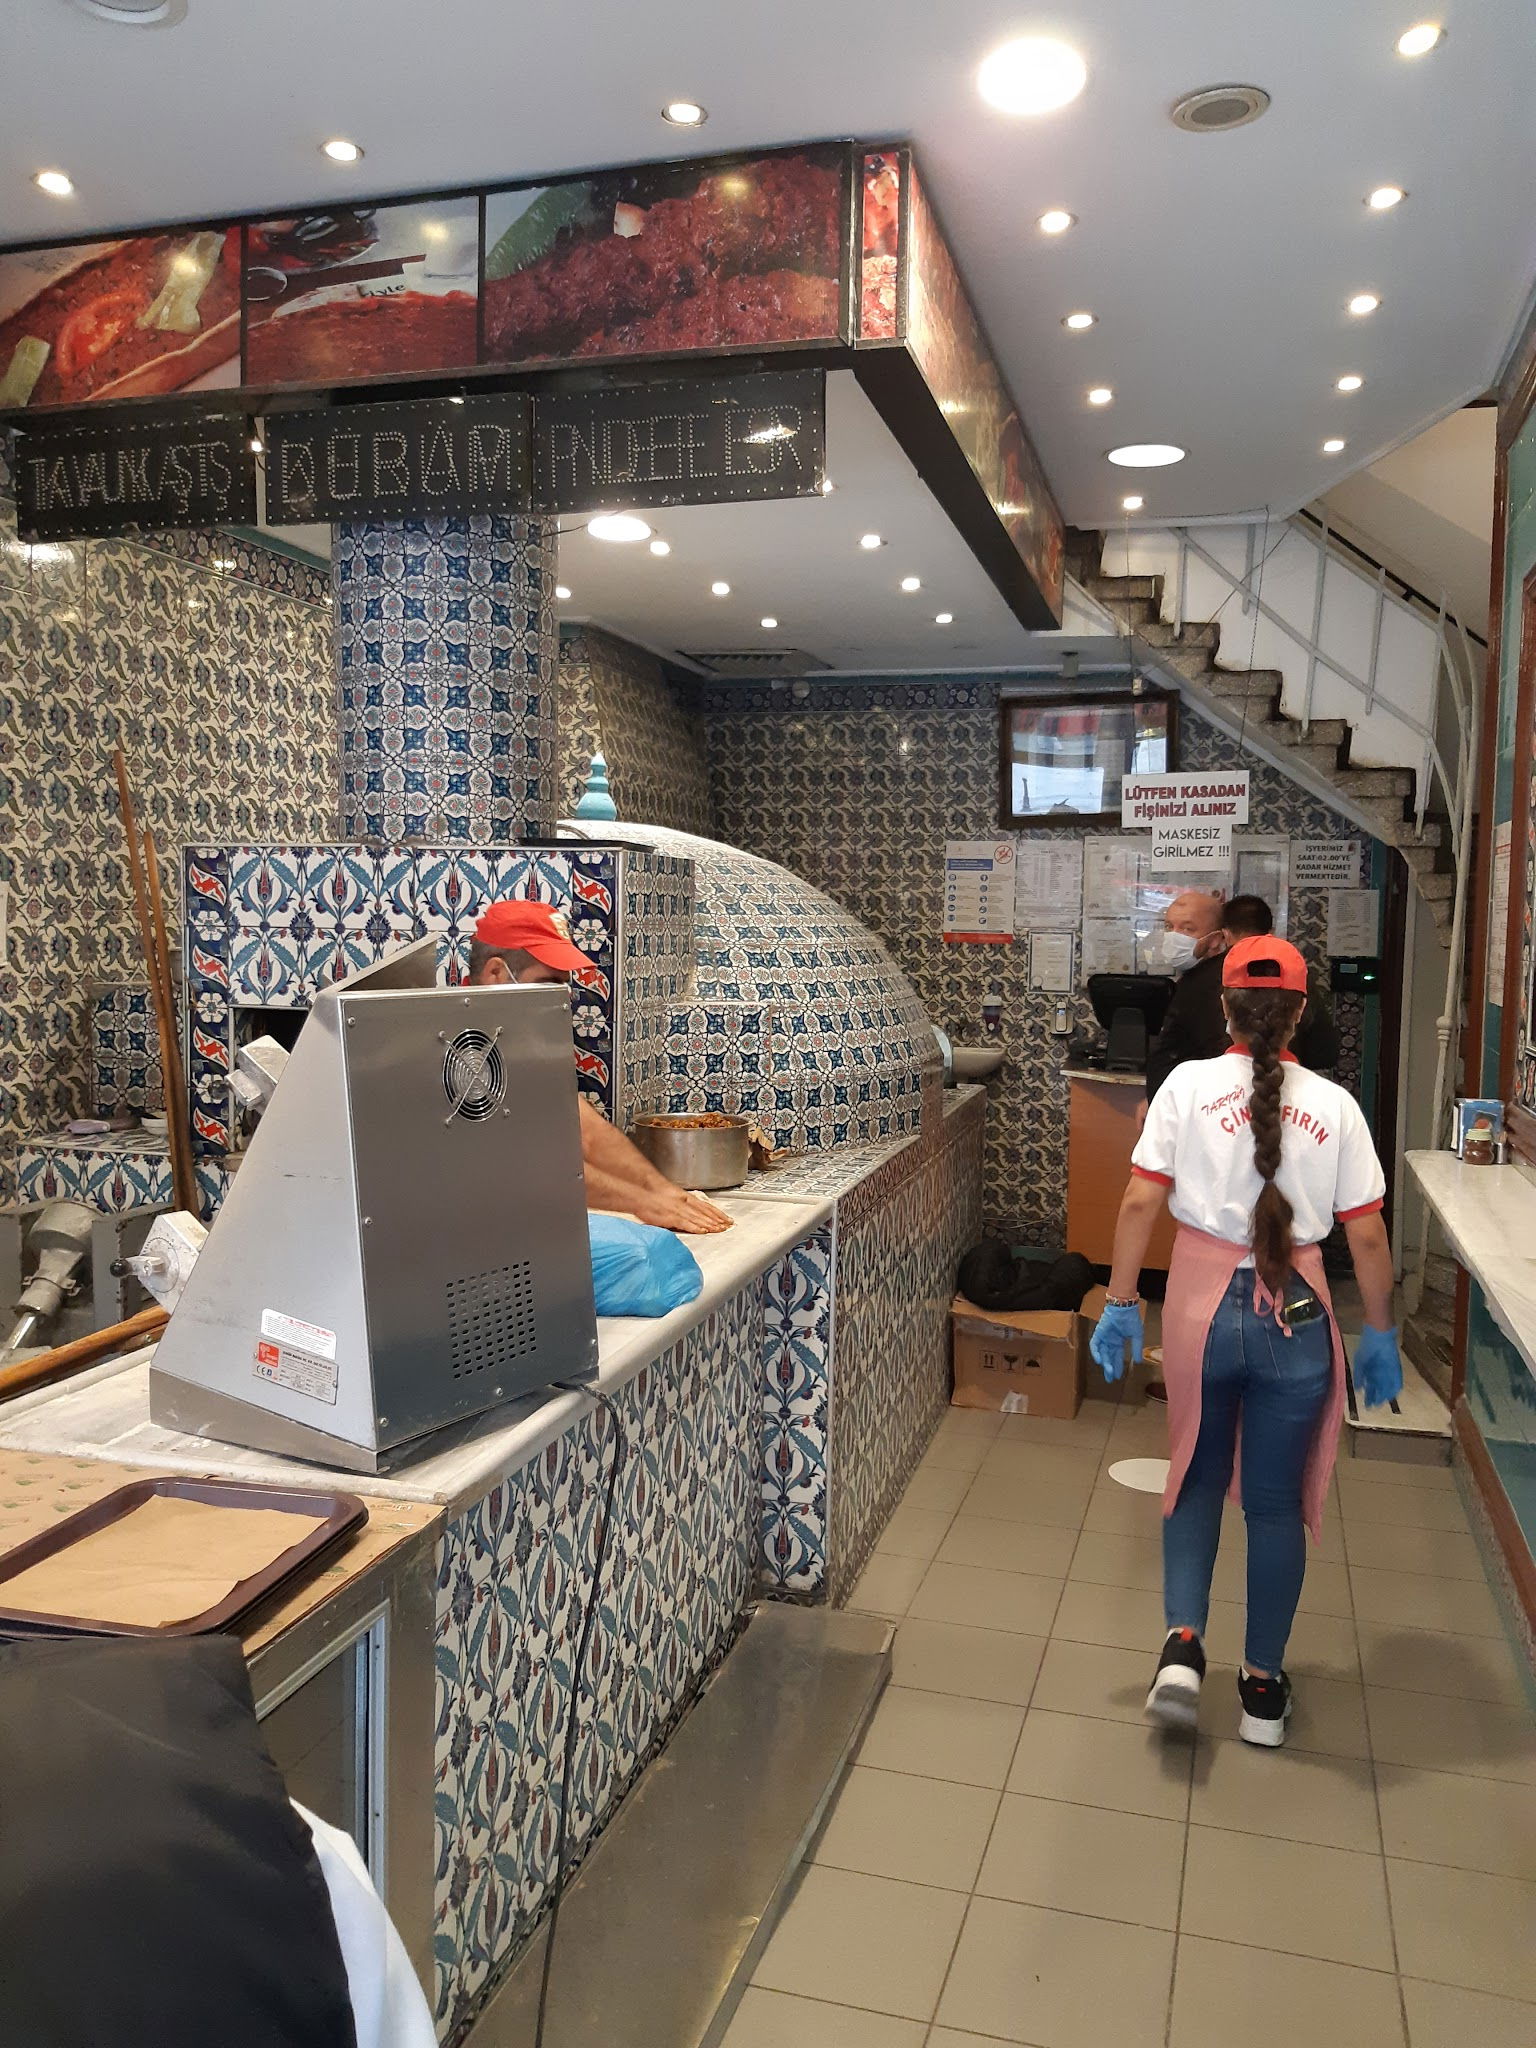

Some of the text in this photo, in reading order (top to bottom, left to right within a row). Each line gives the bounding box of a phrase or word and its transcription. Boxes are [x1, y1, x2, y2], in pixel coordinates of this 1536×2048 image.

[1125, 783, 1246, 801] LÜTFEN KASADAN
[1134, 801, 1237, 820] FİŞİNİZİ ALINIZ
[1158, 826, 1221, 841] MASKESİZ
[1153, 844, 1230, 858] GİRİLMEZ !!!
[1296, 862, 1351, 871] KADAR HİZMET
[1281, 1104, 1330, 1146] FIRIN
